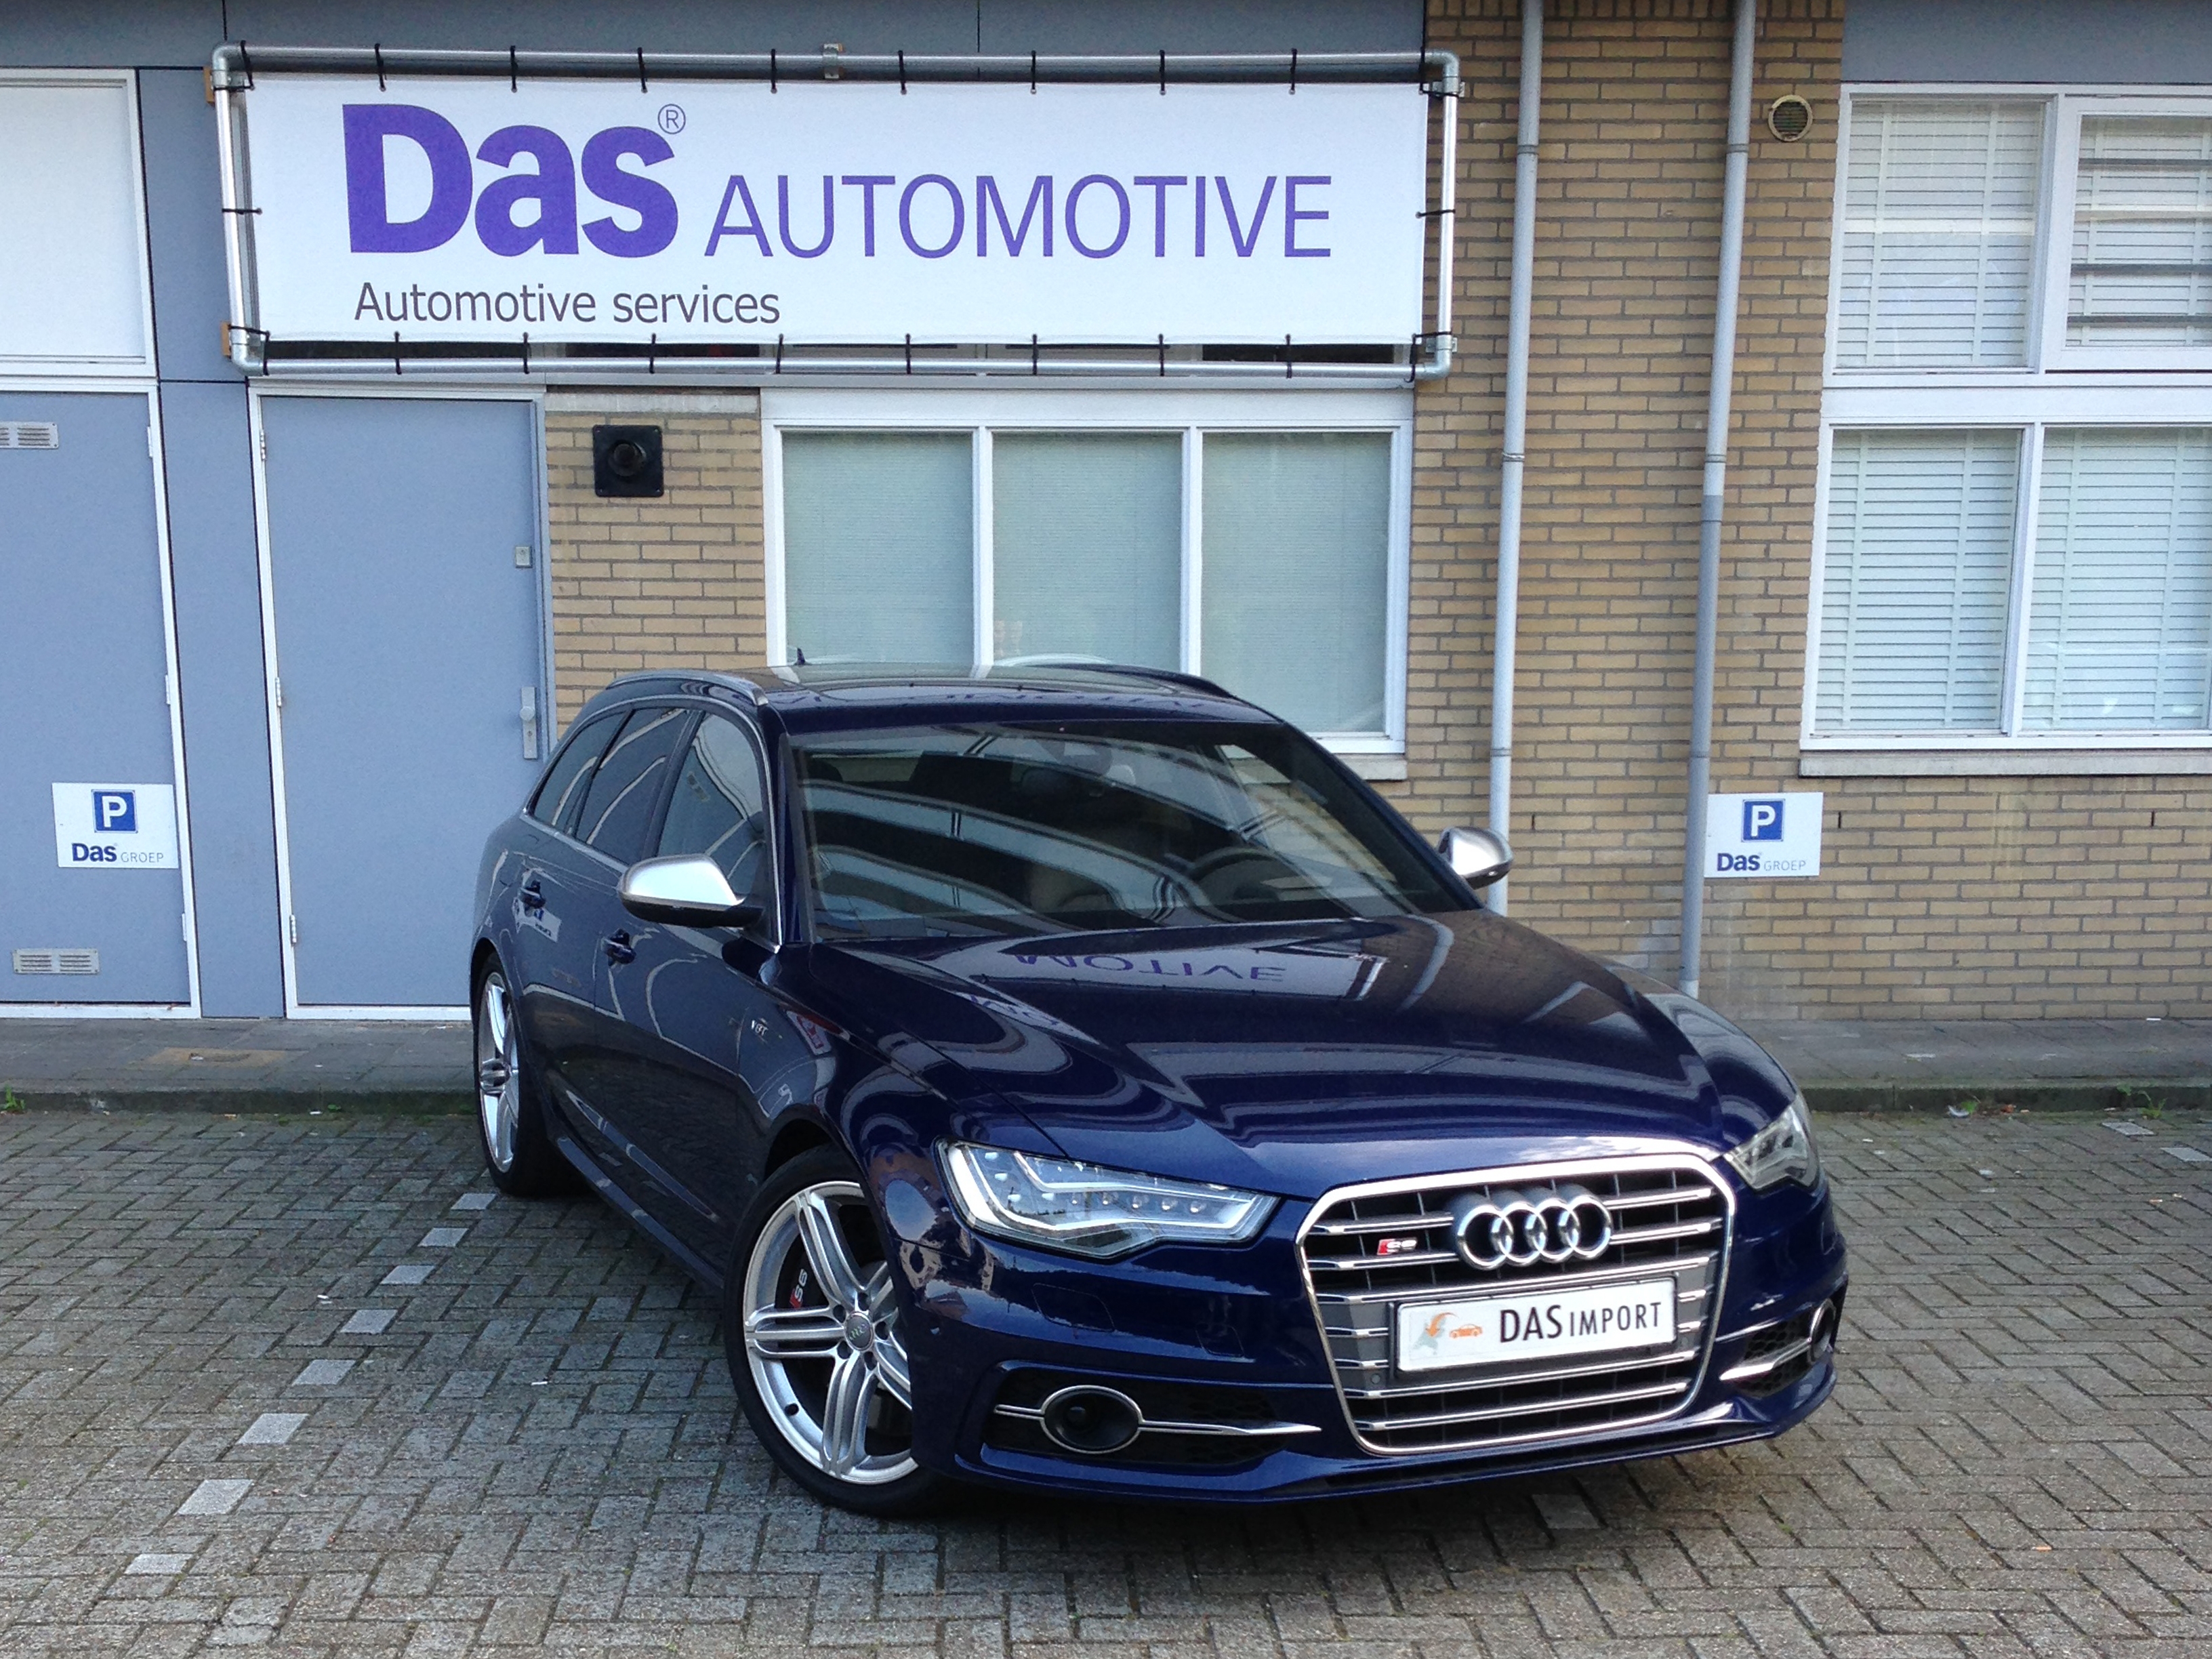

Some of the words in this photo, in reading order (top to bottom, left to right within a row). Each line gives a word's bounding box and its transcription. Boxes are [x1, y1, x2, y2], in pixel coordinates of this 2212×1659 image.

[705, 175, 1332, 258] AUTOMOTIVE
[355, 283, 596, 323] Automotive
[613, 283, 779, 323] services
[102, 796, 127, 828] P
[1750, 805, 1776, 838] P
[72, 842, 117, 862] Das
[121, 852, 164, 863] GROEP
[1717, 853, 1760, 872] Das
[1763, 859, 1807, 872] GROEP
[1500, 1305, 1562, 1343] DAS
[1569, 1301, 1662, 1338] IMPORT
